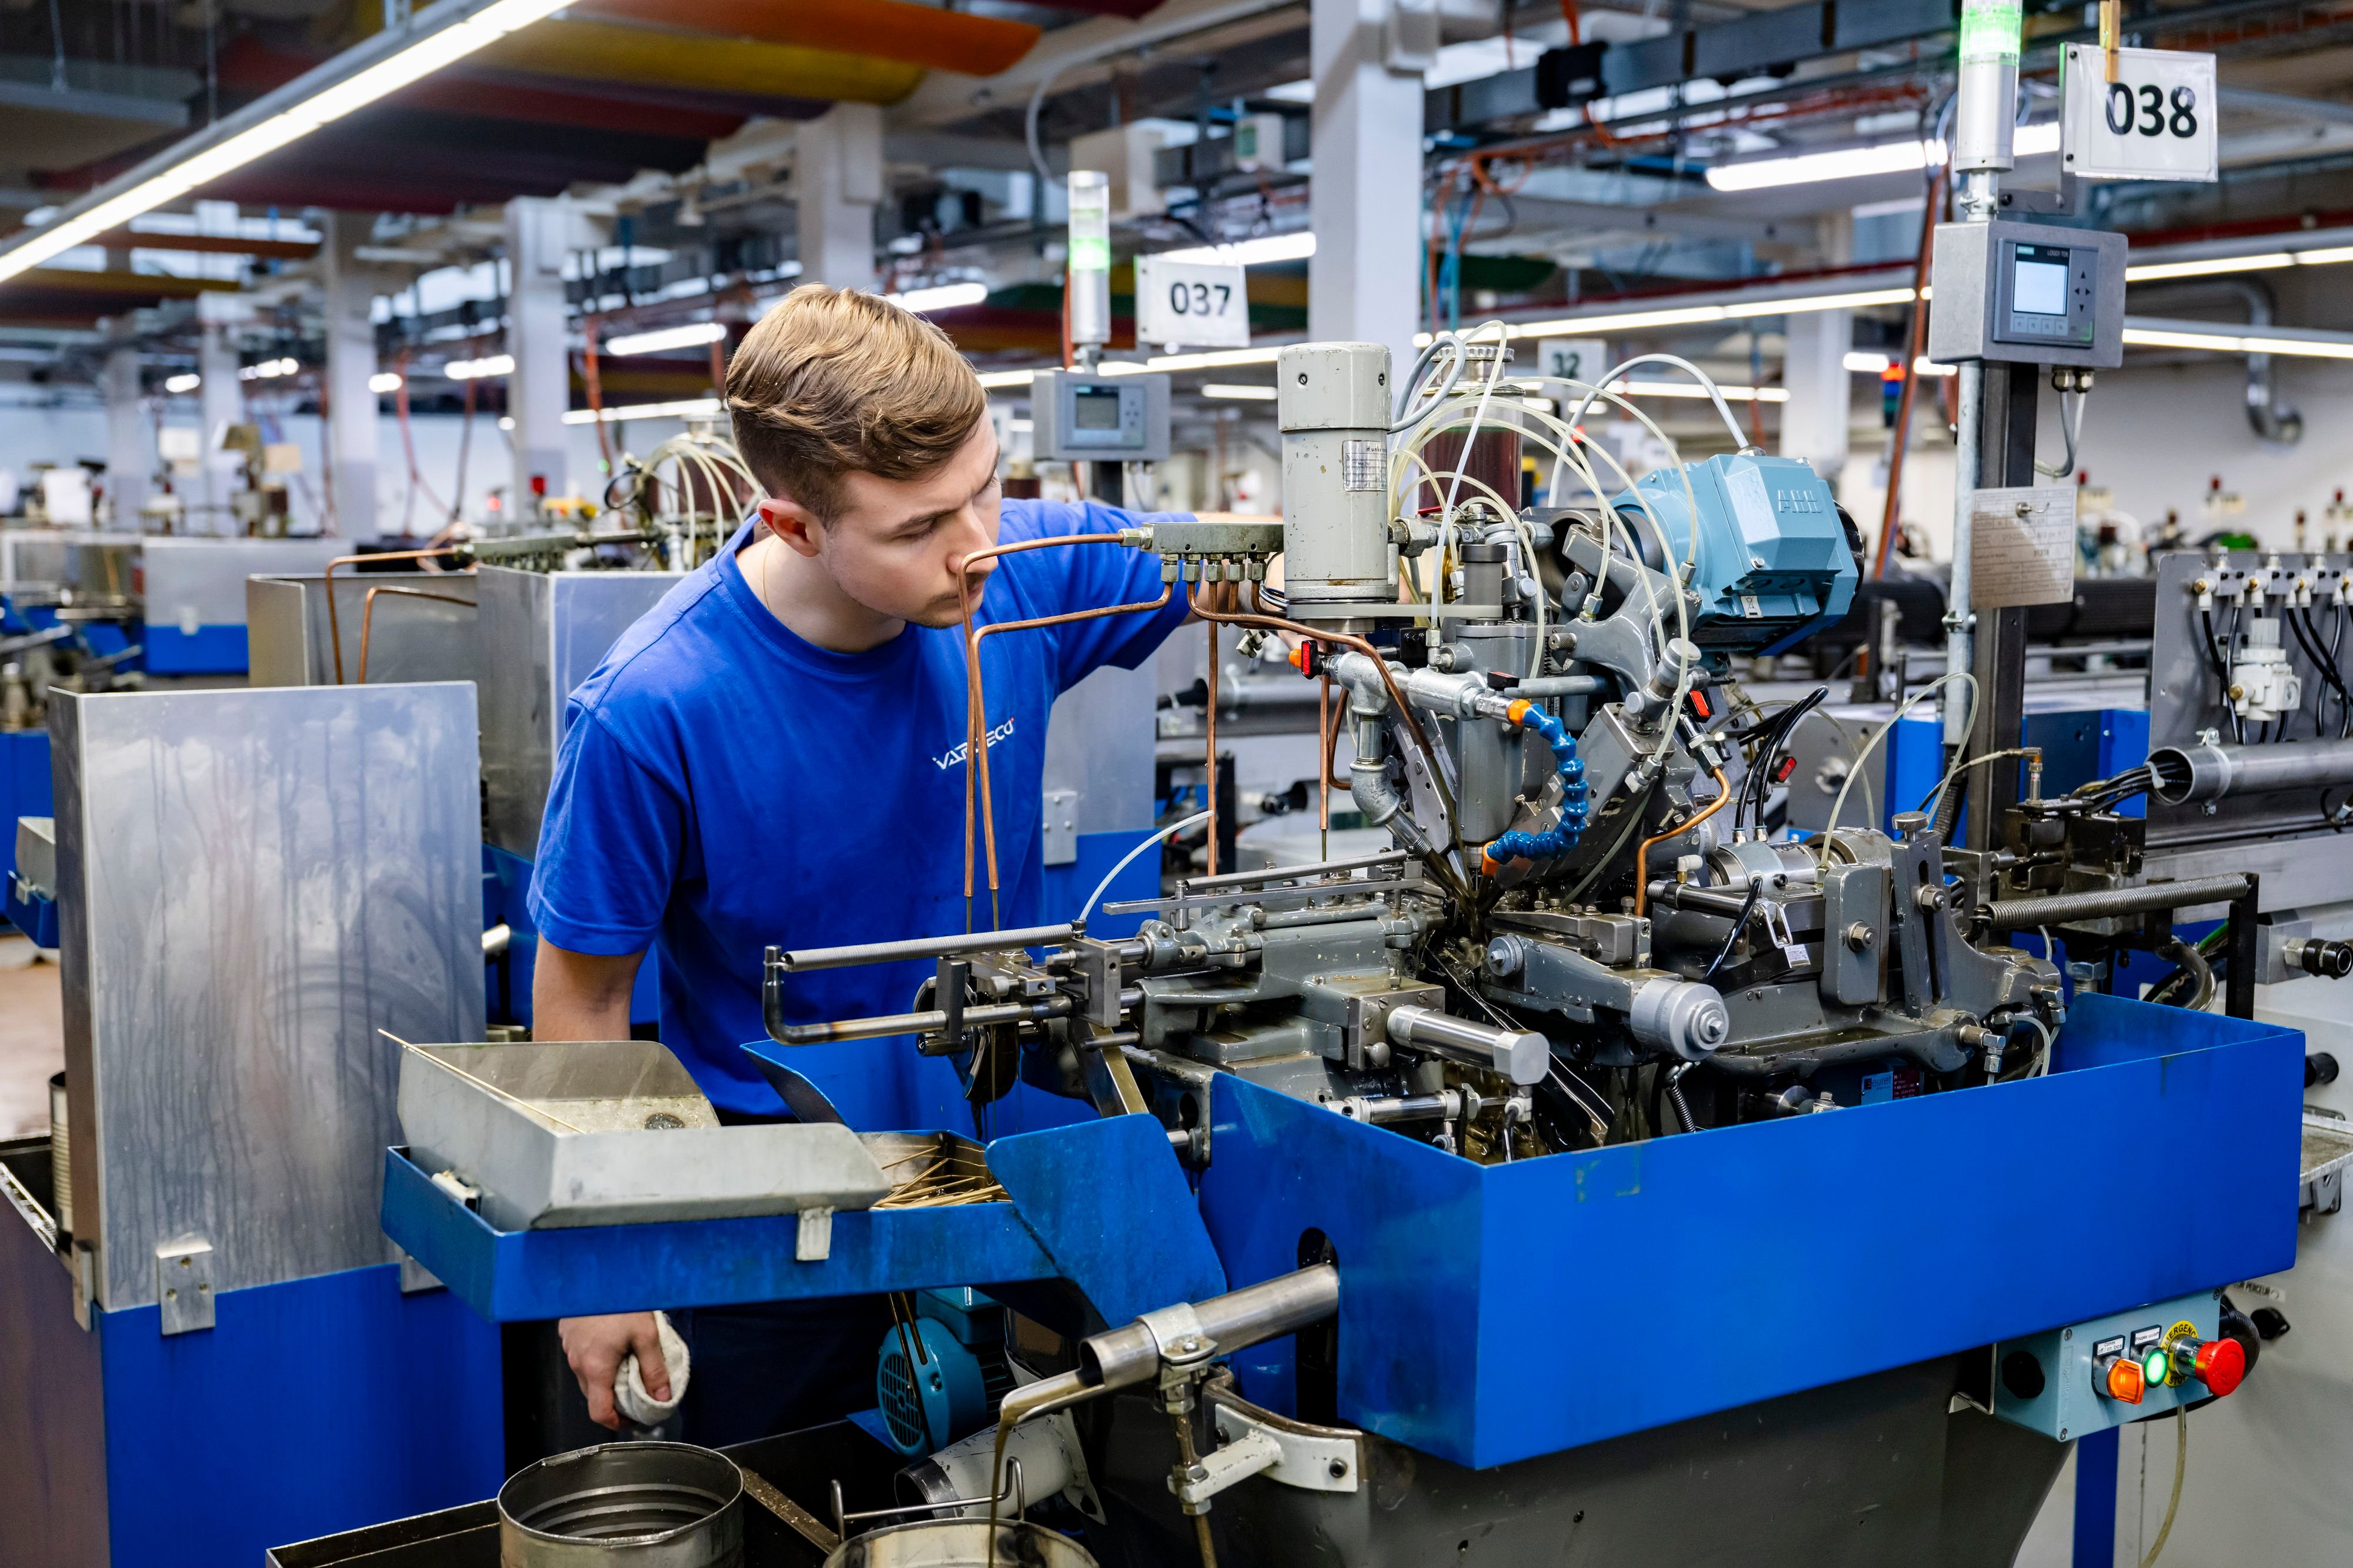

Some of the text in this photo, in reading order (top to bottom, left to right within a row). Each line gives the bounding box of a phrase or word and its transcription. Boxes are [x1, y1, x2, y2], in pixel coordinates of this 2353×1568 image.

[2106, 83, 2198, 138] 038
[1171, 282, 1231, 316] 037
[1552, 352, 1580, 379] 32
[1778, 489, 1822, 513] ABB
[932, 718, 1015, 770] VARECO
[2162, 1325, 2197, 1350] EMERGENC
